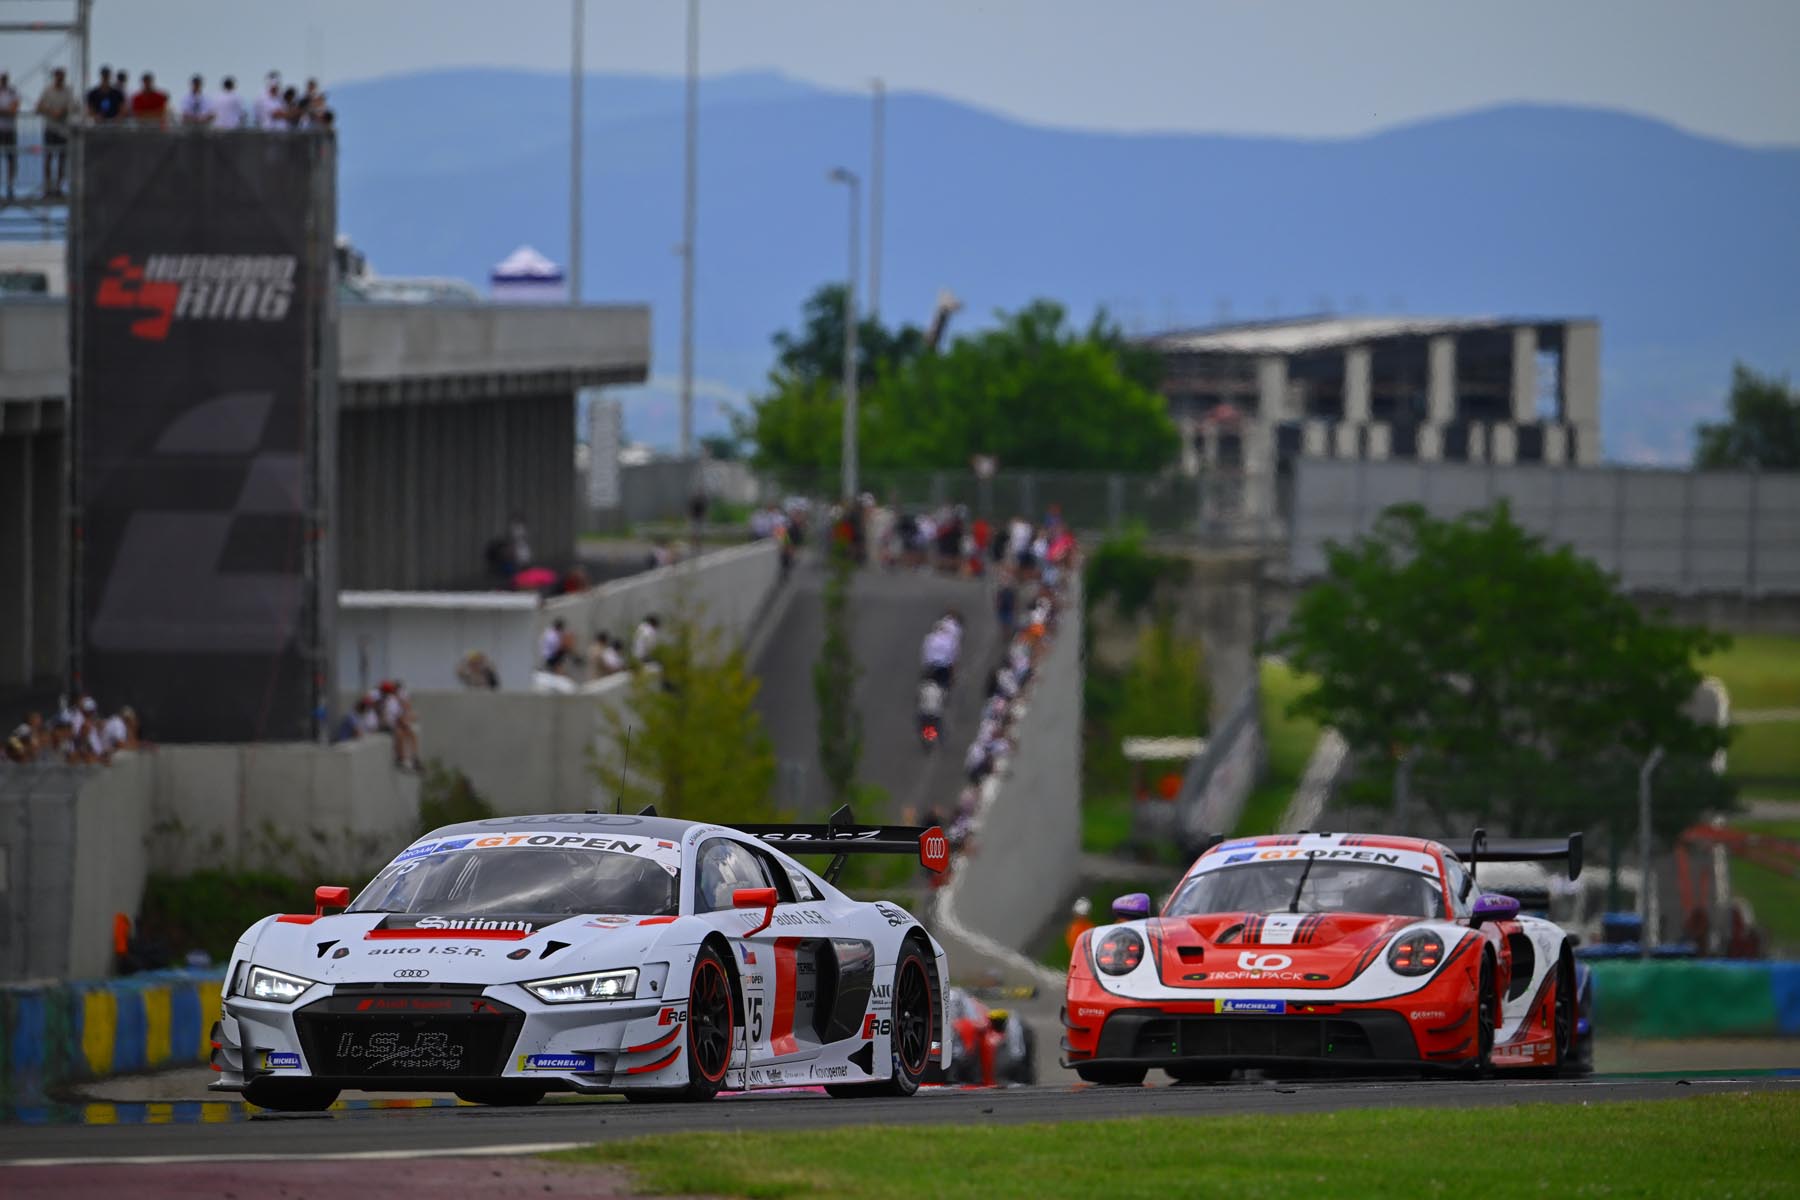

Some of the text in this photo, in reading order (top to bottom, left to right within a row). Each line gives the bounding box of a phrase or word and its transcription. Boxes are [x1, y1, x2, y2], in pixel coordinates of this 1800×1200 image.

[175, 279, 295, 319] RING
[368, 946, 421, 956] auto
[870, 1019, 891, 1036] R8
[537, 1059, 586, 1067] MICHELIN
